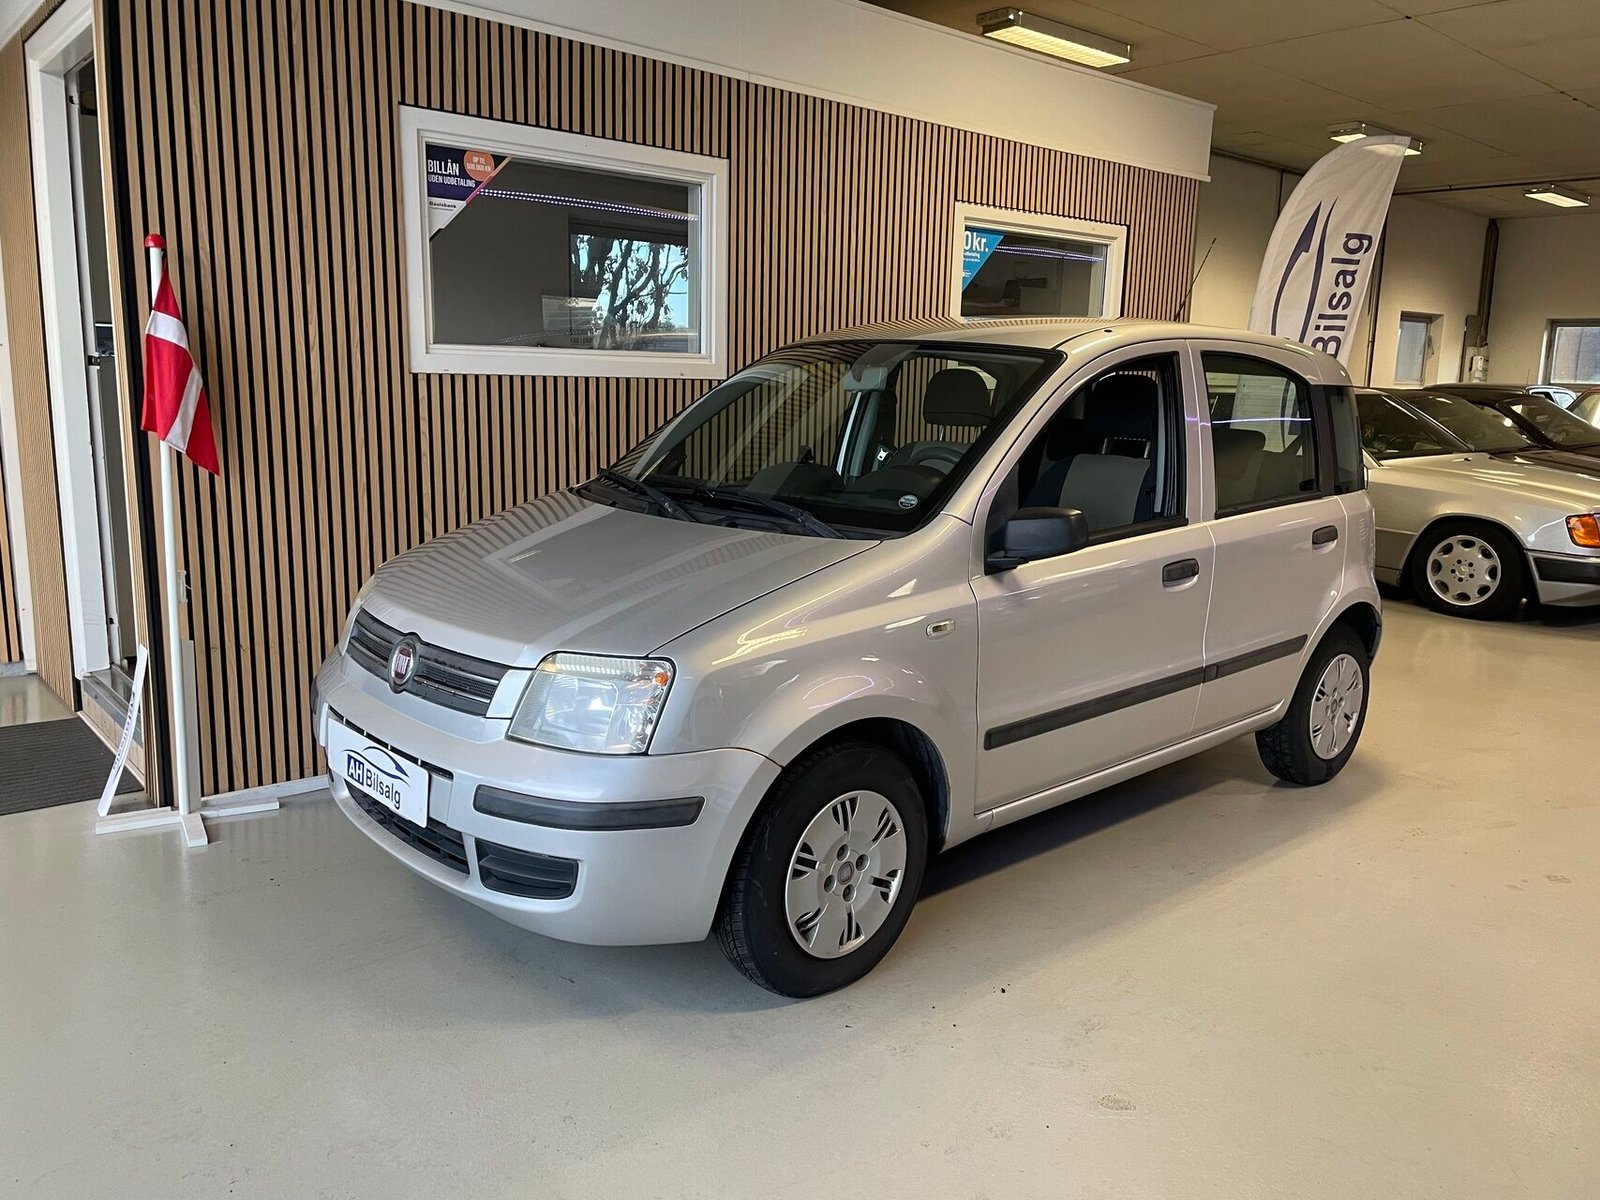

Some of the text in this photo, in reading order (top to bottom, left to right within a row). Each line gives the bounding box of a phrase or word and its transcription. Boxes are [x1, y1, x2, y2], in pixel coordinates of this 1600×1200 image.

[427, 158, 460, 176] BILLÅN
[427, 174, 476, 188] UDEN UDBETALING
[1311, 232, 1373, 359] Bilsalg
[348, 756, 401, 810] AH Bilsalg
